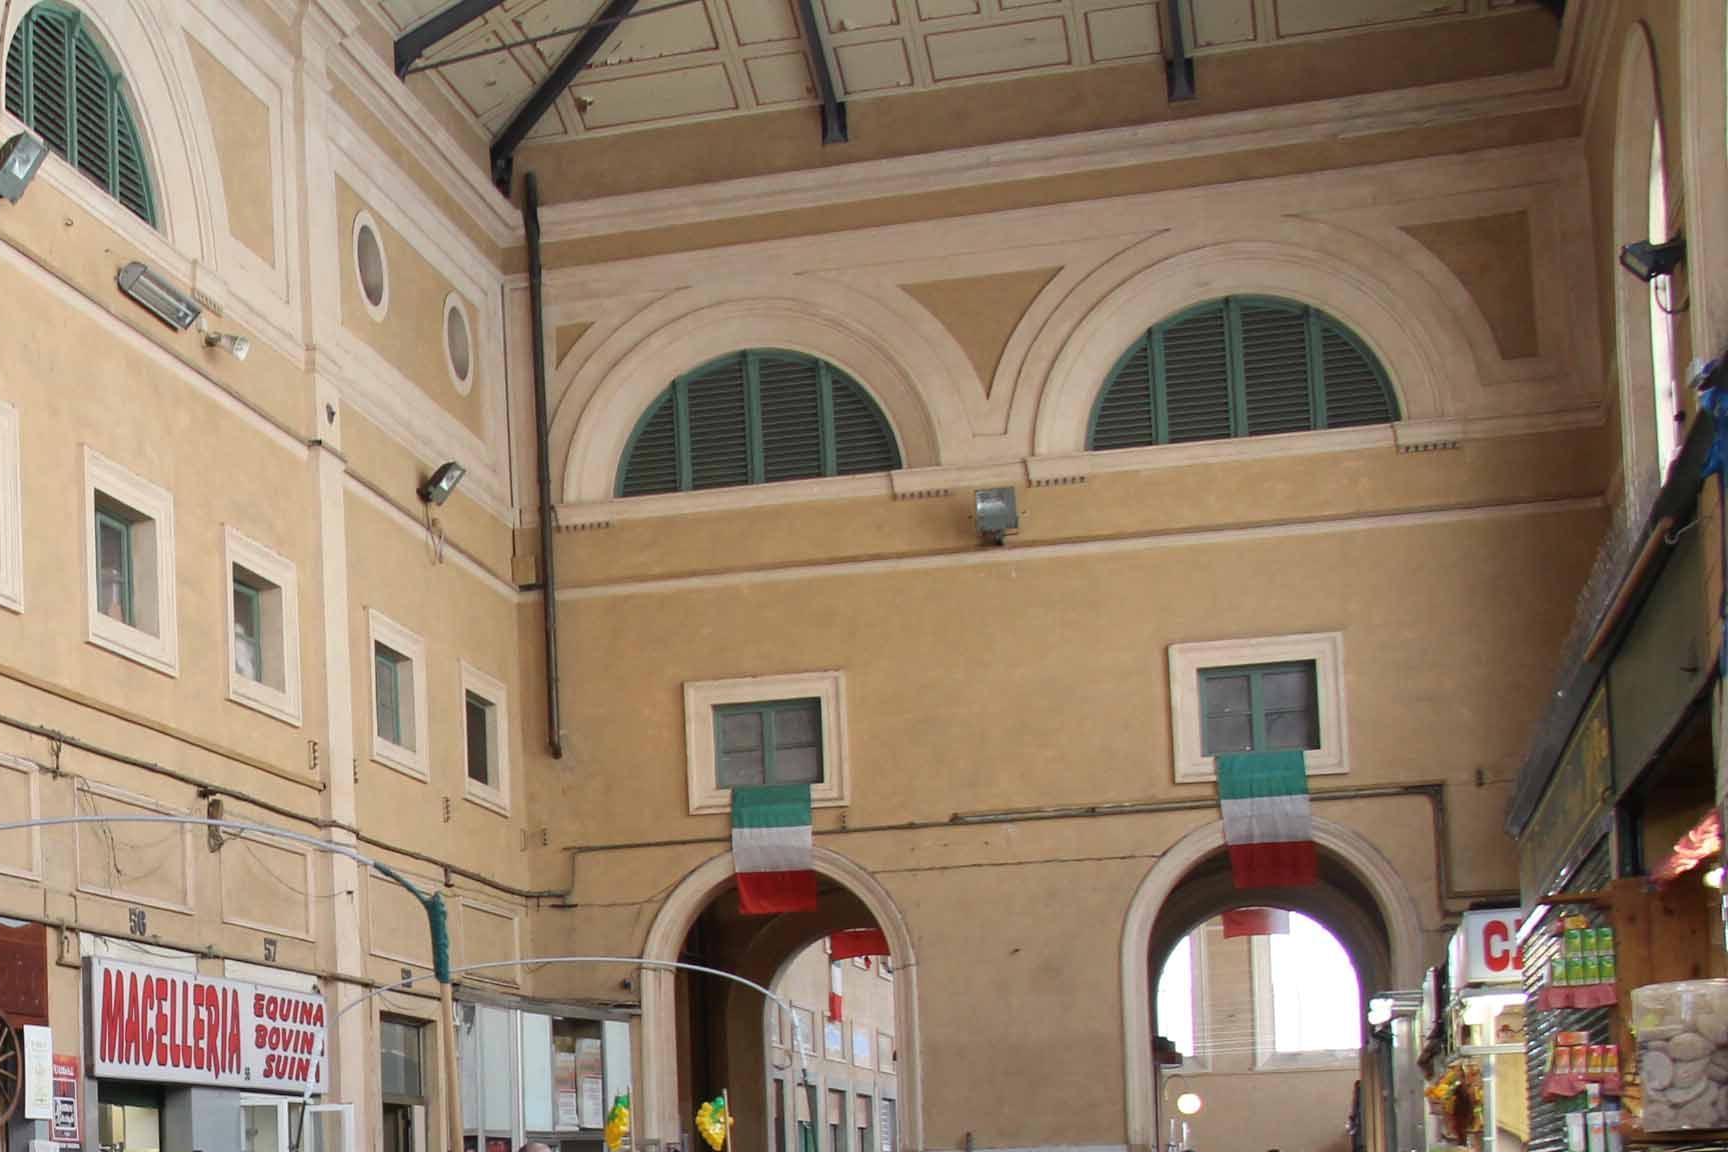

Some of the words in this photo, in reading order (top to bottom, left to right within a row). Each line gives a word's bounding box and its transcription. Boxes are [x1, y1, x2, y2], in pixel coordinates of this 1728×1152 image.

[264, 938, 277, 961] 57
[100, 968, 241, 1079] MACELLERIA
[253, 993, 324, 1027] EQUINA
